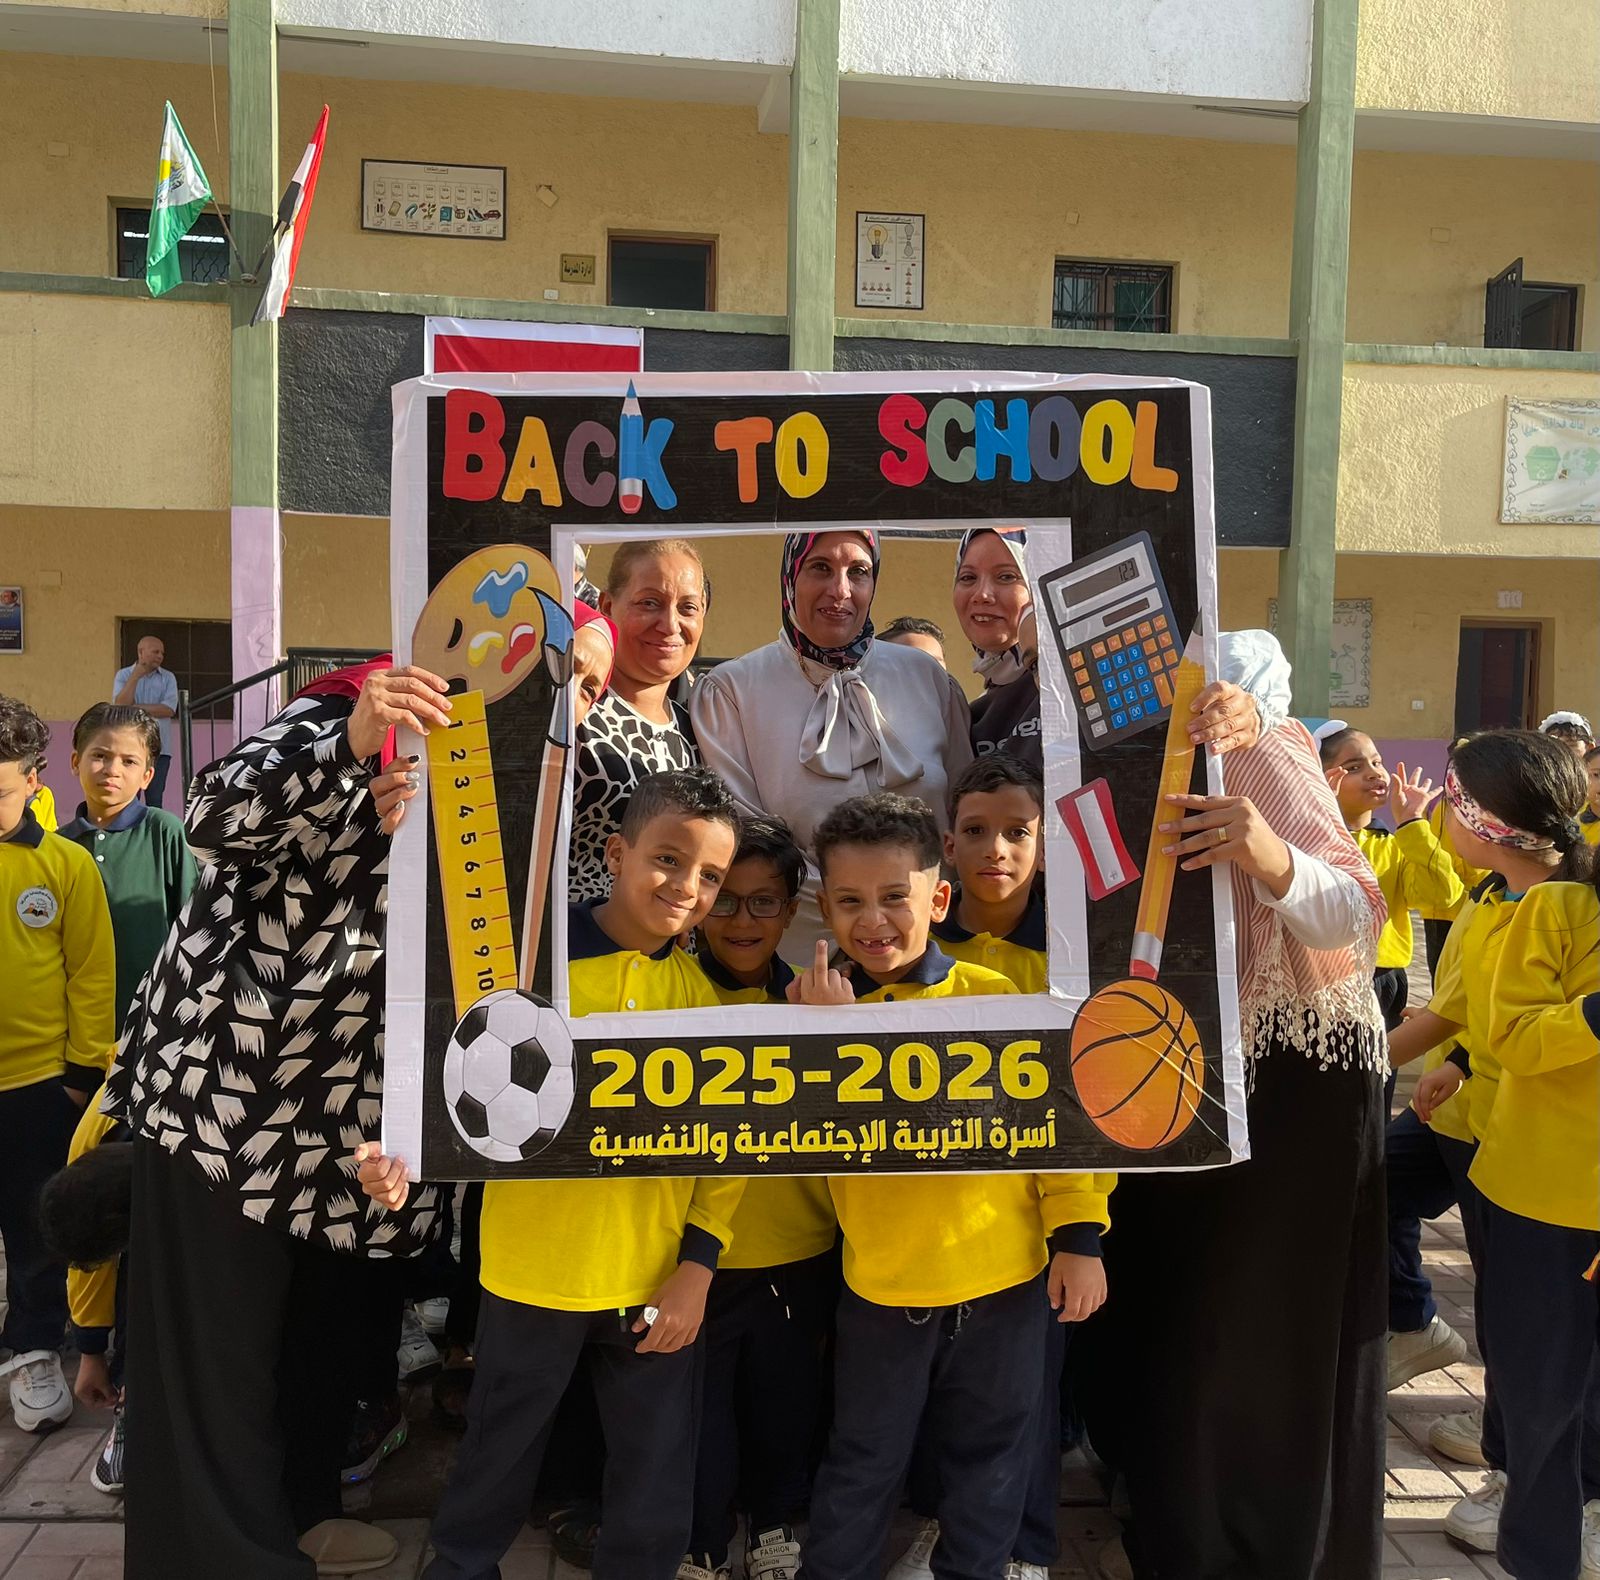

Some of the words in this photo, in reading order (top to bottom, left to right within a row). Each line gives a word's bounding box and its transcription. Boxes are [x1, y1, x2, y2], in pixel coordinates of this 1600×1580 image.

[442, 379, 678, 514] BACK
[714, 411, 830, 503] TO
[878, 394, 1179, 492] SCHOOL
[1118, 560, 1136, 581] 123
[1101, 662, 1106, 671] 7
[1117, 656, 1123, 664] 8
[1132, 649, 1138, 657] 9
[1107, 681, 1113, 689] 4
[1122, 674, 1128, 682] 5
[1138, 667, 1144, 675] 6
[1128, 691, 1134, 699] 2
[1144, 684, 1150, 693] 3
[447, 719, 463, 730] 1
[450, 748, 466, 762] 2
[454, 775, 470, 789] 3
[458, 804, 474, 818] 4
[461, 831, 477, 845] 5
[464, 860, 481, 873] 6
[466, 887, 482, 900] 7
[470, 917, 487, 931] 8
[474, 944, 490, 958] 9
[477, 967, 494, 992] 10
[588, 1040, 1050, 1108] 2025-2026
[734, 1118, 887, 1164] الإجتماعية
[893, 1117, 983, 1160] التربية
[989, 1108, 1058, 1160] أسرة
[588, 1122, 727, 1165] والنفسية
[762, 1534, 782, 1545] FASHION
[760, 1545, 790, 1557] FASHION
[680, 1564, 709, 1579] FASHION
